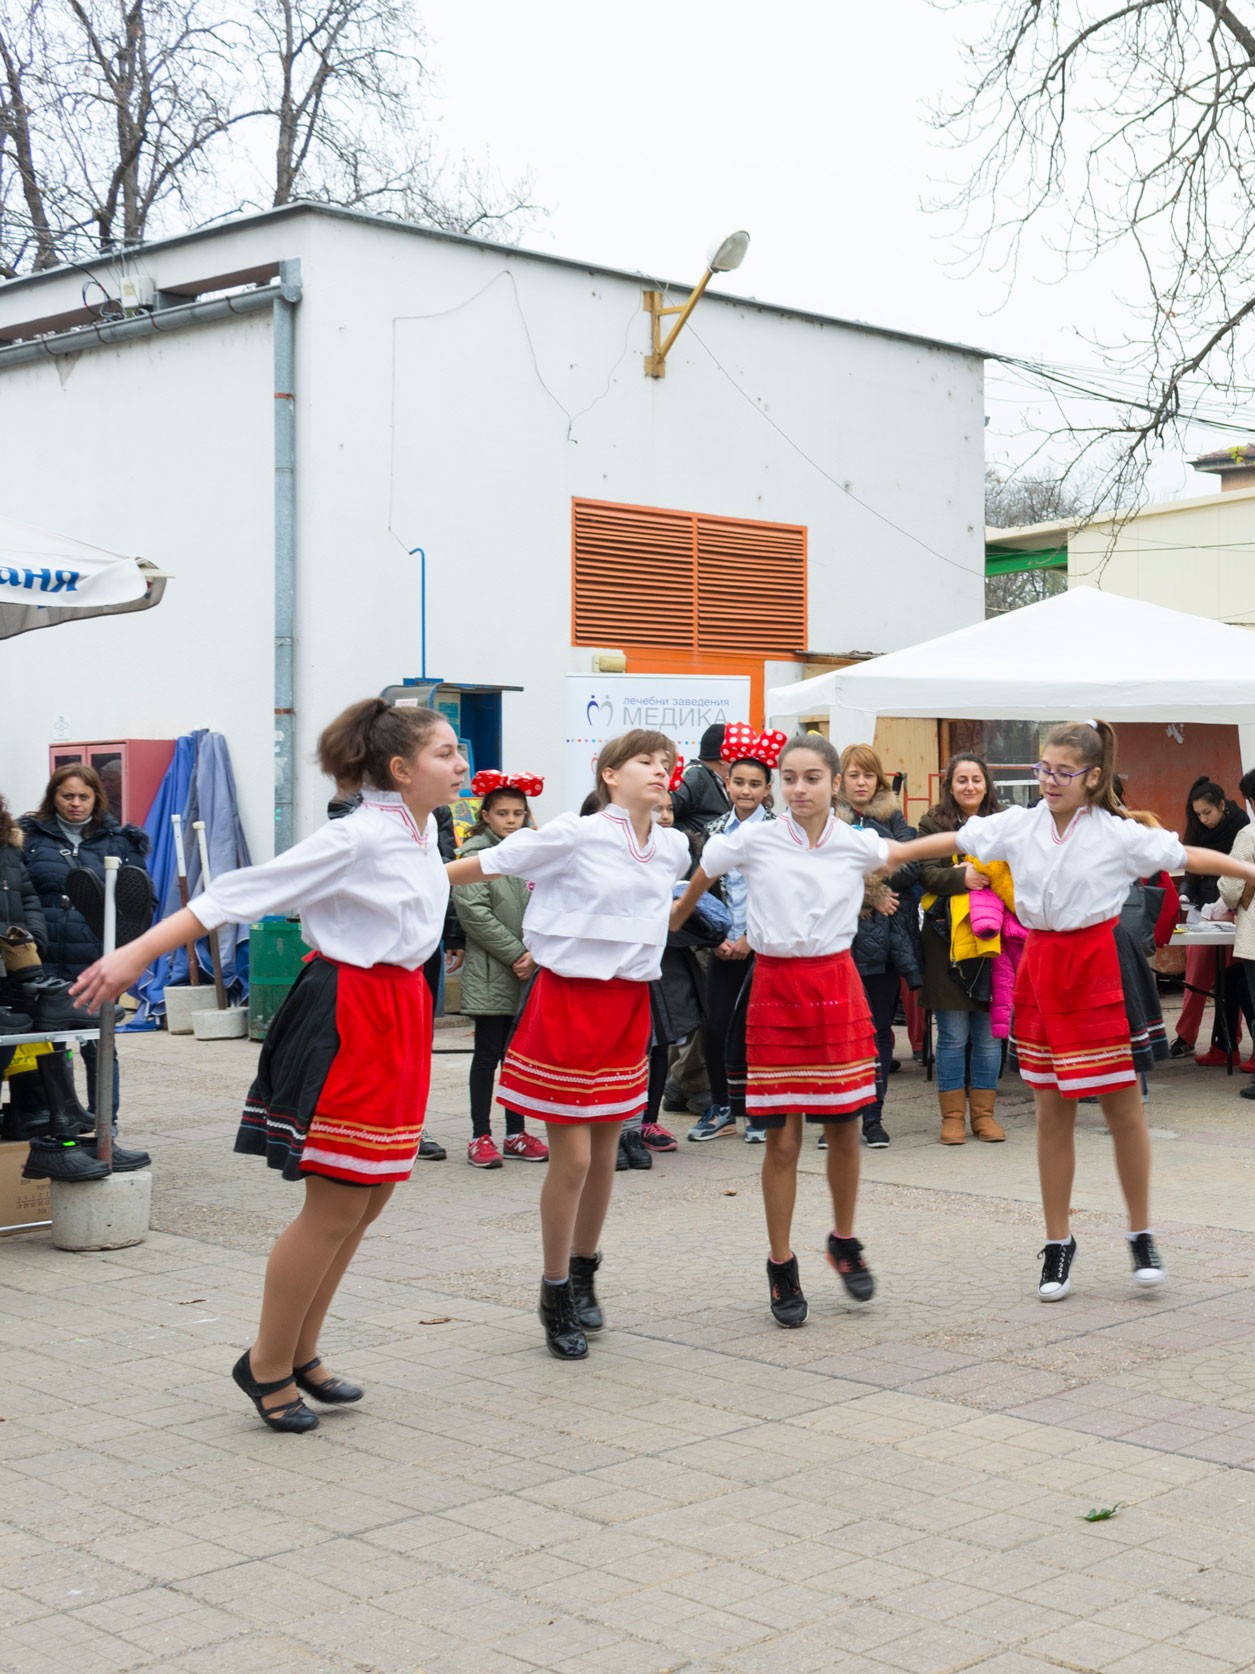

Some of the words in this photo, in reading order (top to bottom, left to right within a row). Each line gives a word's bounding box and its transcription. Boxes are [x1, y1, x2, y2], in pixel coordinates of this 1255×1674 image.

[0, 566, 80, 593] аня
[623, 696, 669, 705] лечебни
[672, 697, 730, 708] заведения
[623, 707, 727, 729] МЕДИКА
